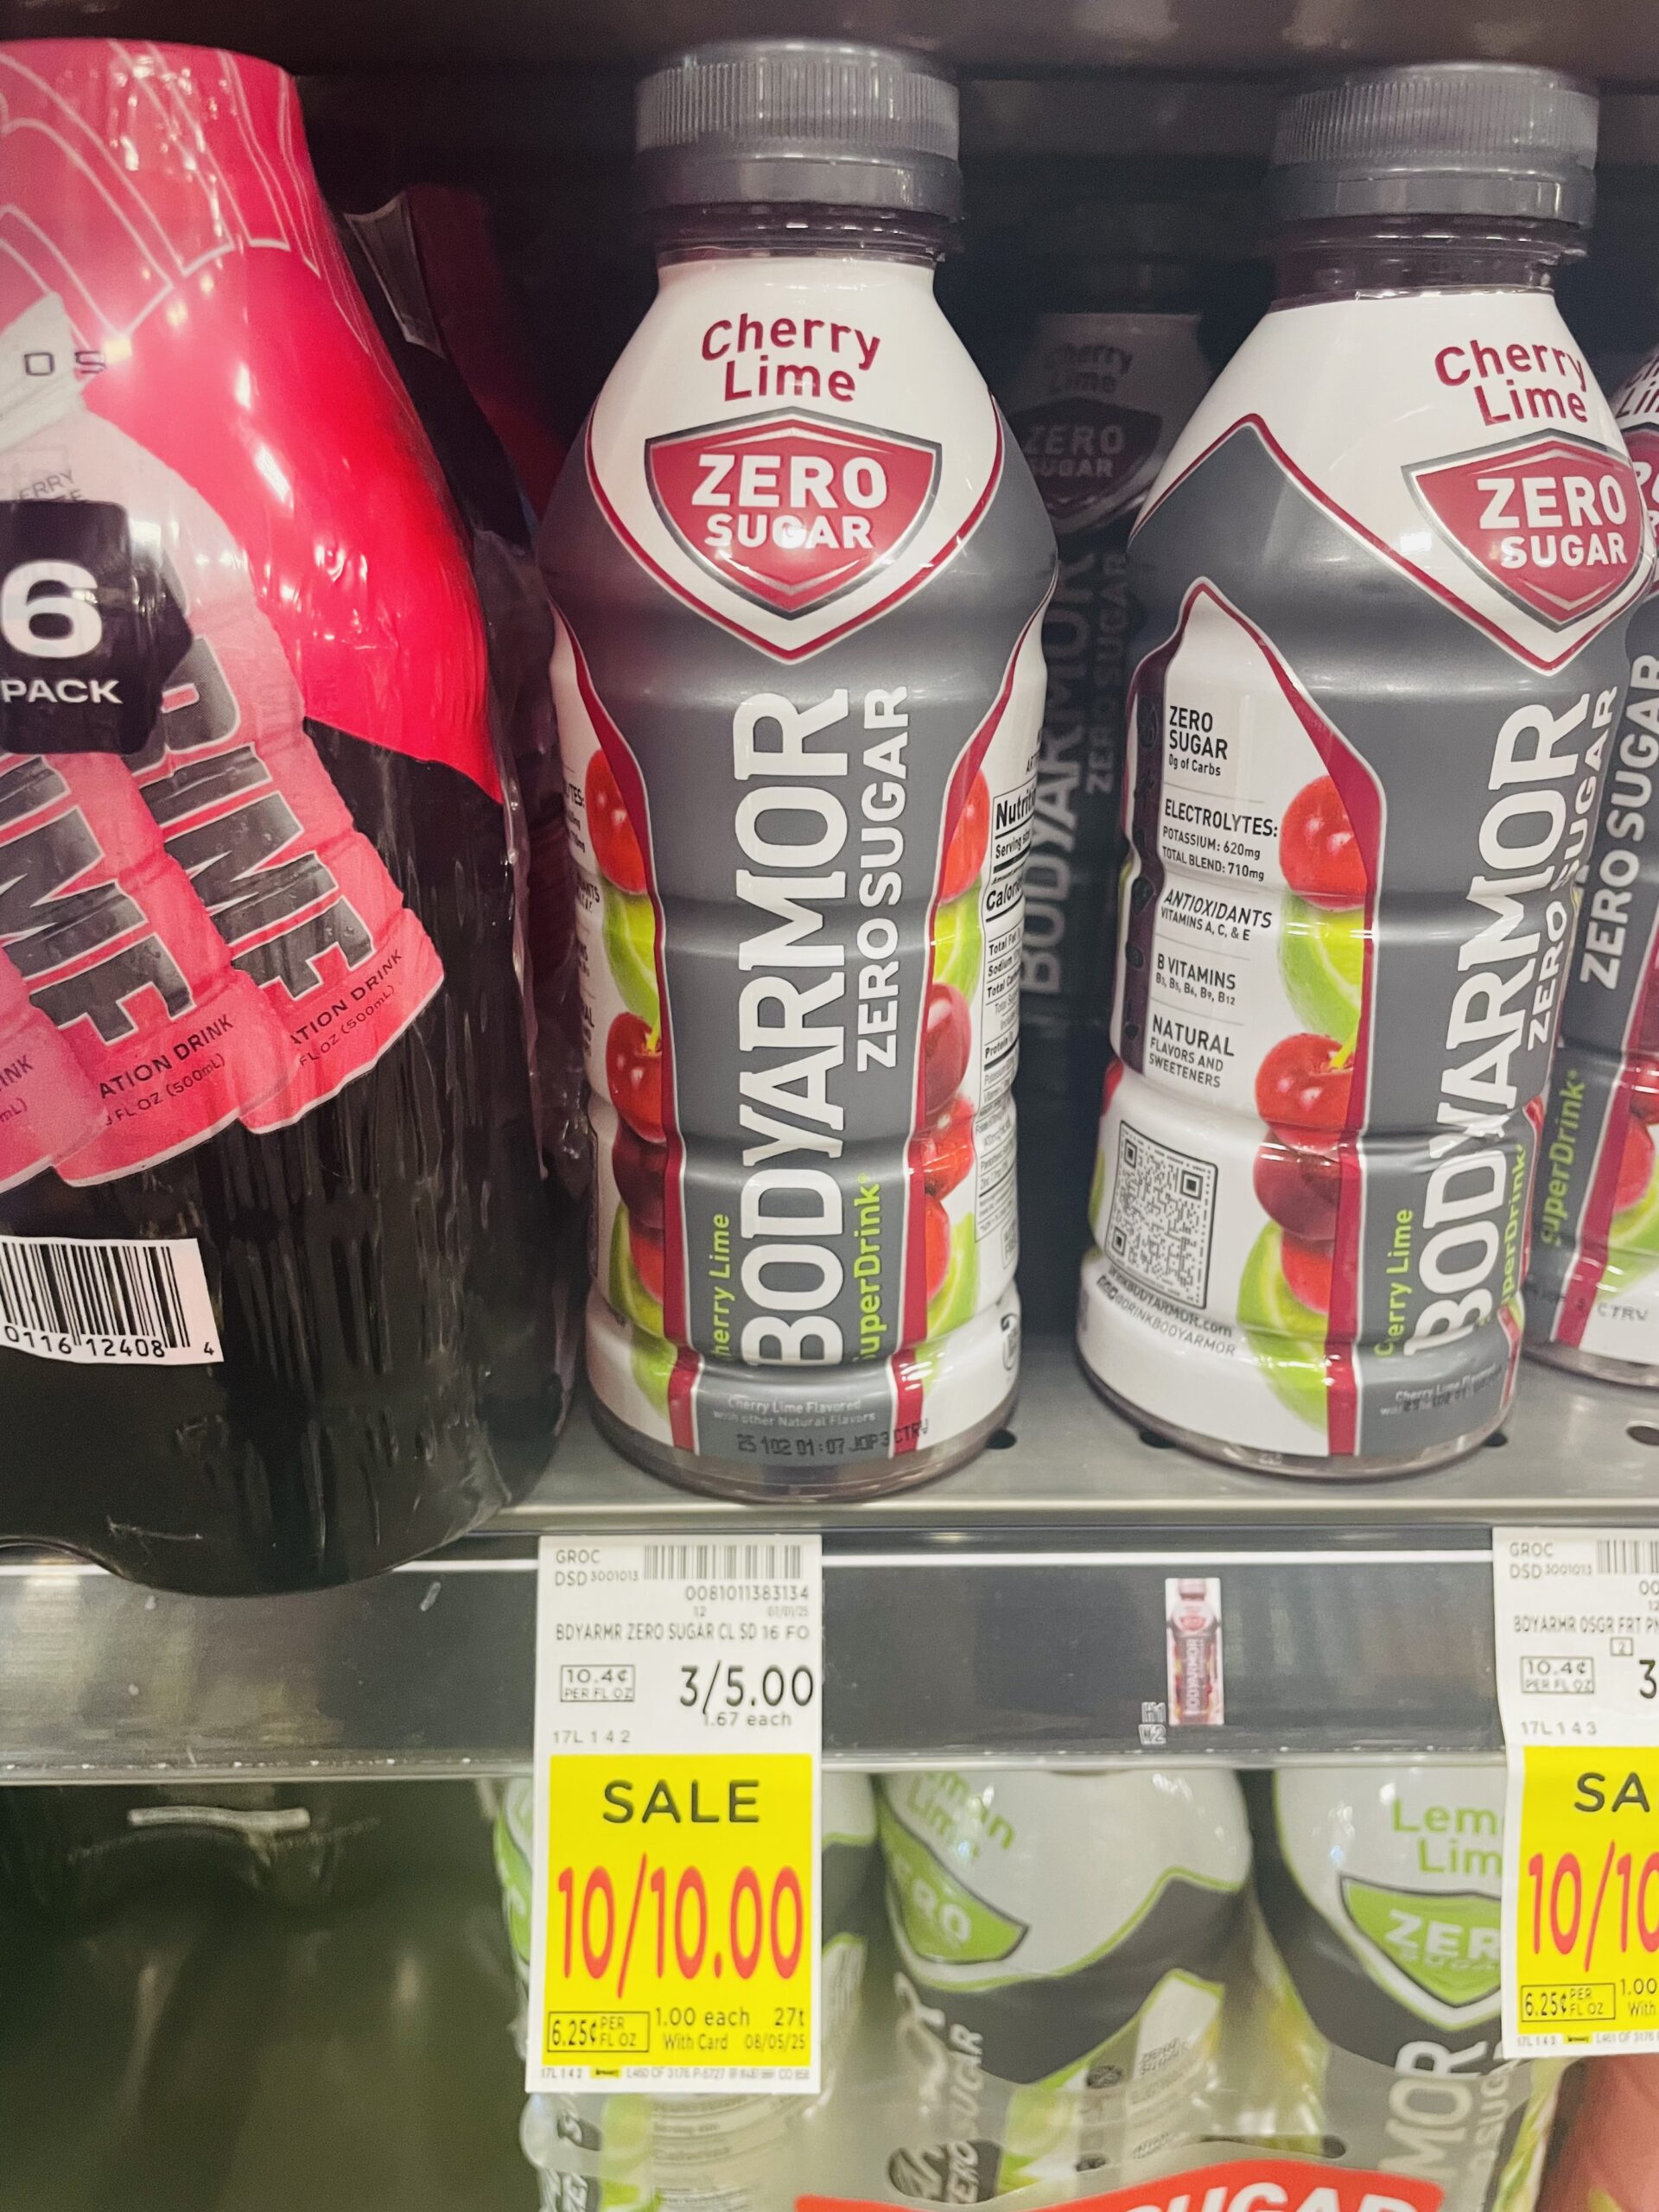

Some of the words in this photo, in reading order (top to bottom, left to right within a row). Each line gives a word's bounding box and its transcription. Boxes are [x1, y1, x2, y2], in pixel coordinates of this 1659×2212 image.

[702, 313, 880, 372] Cherry
[724, 355, 856, 402] Lime
[1433, 339, 1588, 393] Cherry
[1473, 383, 1588, 426] Lime
[692, 454, 888, 509] ZERO
[1476, 474, 1629, 531] ZERO
[703, 514, 874, 550] SUGAR
[1500, 532, 1629, 568] SUGAR
[3, 560, 103, 658] 6
[1, 678, 123, 705] PACK
[1169, 705, 1214, 734] ZERO
[1169, 730, 1229, 760] SUGAR
[1168, 753, 1179, 770] 0g
[1180, 756, 1190, 770] of
[1192, 759, 1222, 777] Carbs
[859, 686, 910, 907] SUGAR
[1165, 798, 1278, 838] ELECTROLYTES:
[1163, 825, 1221, 852] POTASSIUM:
[1223, 841, 1261, 861] 620mg
[1162, 846, 1187, 864] TOTAL
[1189, 853, 1225, 874] BLEND:
[1228, 861, 1264, 882] 710mg
[1160, 906, 1203, 931] VITAMINS
[1230, 927, 1240, 940] &
[1243, 929, 1251, 942] E
[1163, 889, 1273, 929] ANTIOXIDANTS
[1580, 849, 1640, 990] ZERO
[988, 938, 1007, 957] Total
[350, 949, 403, 1001] DRINK
[1156, 953, 1165, 971] B
[1167, 956, 1236, 991] VITAMINS
[1526, 900, 1568, 1052] ZERO
[855, 917, 899, 1072] ZERO
[987, 981, 1005, 999] Total
[299, 1048, 320, 1067] FL
[313, 1033, 340, 1056] OZ
[341, 984, 395, 1035] (500mL)
[733, 688, 849, 1366] BODYARMOR
[1152, 1014, 1236, 1058] NATURAL
[99, 1054, 173, 1099] ATION
[173, 1014, 234, 1061] DRINK
[1148, 1053, 1222, 1090] SWEETENERS
[1150, 1037, 1196, 1065] FLAVORS
[1198, 1052, 1224, 1072] AND
[137, 1091, 164, 1111] OZ
[166, 1052, 226, 1097] (500mL)
[709, 1212, 731, 1279] Lime
[1386, 1209, 1414, 1274] Lime
[86, 1338, 166, 1358] 12408
[203, 1341, 215, 1356] 4
[728, 1396, 771, 1414] Cherry
[772, 1400, 804, 1414] Lime
[805, 1398, 861, 1414] Flavored
[741, 1412, 774, 1427] other
[778, 1414, 827, 1427] Natural
[830, 1410, 876, 1425] Flavors
[797, 1437, 845, 1457] 01:07
[556, 1549, 601, 1565] GROC
[1510, 1542, 1554, 1558] GROC
[555, 1570, 588, 1587] DSD
[1510, 1563, 1541, 1580] DSD
[556, 1623, 622, 1641] BDYARMR
[626, 1623, 664, 1640] ZERO
[668, 1623, 715, 1640] SUGAR
[719, 1623, 736, 1640] CL
[740, 1623, 758, 1640] SD
[762, 1624, 779, 1639] 16
[785, 1624, 810, 1639] FO
[1618, 1616, 1642, 1633] FRT
[1525, 1677, 1550, 1691] PER
[1527, 1659, 1587, 1675] 10.4¢
[563, 1686, 589, 1700] PER
[594, 1686, 608, 1700] FL
[566, 1667, 629, 1684] 10.4¢
[679, 1659, 814, 1715] 3/5.00
[702, 1711, 740, 1726] 1.67
[747, 1710, 792, 1726] each
[1521, 1721, 1553, 1736] 17L
[1571, 1721, 1582, 1735] 4
[1587, 1720, 1598, 1735] 3
[553, 1731, 584, 1744] 17L
[605, 1731, 614, 1744] 4
[620, 1731, 632, 1744] 2
[603, 1777, 761, 1824] SALE
[558, 1852, 804, 1999] 10/10.00
[1524, 1991, 1568, 2018] 6.25¢
[1570, 1987, 1592, 2000] PER
[1619, 1978, 1658, 1996] 1.00
[655, 2006, 696, 2026] 1.00
[704, 2006, 751, 2026] each
[1570, 2002, 1585, 2016] FL
[1588, 2001, 1605, 2015] OZ
[1628, 2001, 1656, 2018] With
[551, 2018, 598, 2047] 6.25¢
[600, 2016, 625, 2030] PER
[600, 2032, 617, 2047] FL
[620, 2032, 638, 2047] OZ
[662, 2032, 695, 2050] With
[697, 2032, 729, 2050] Card
[744, 2032, 807, 2051] 08/05/25
